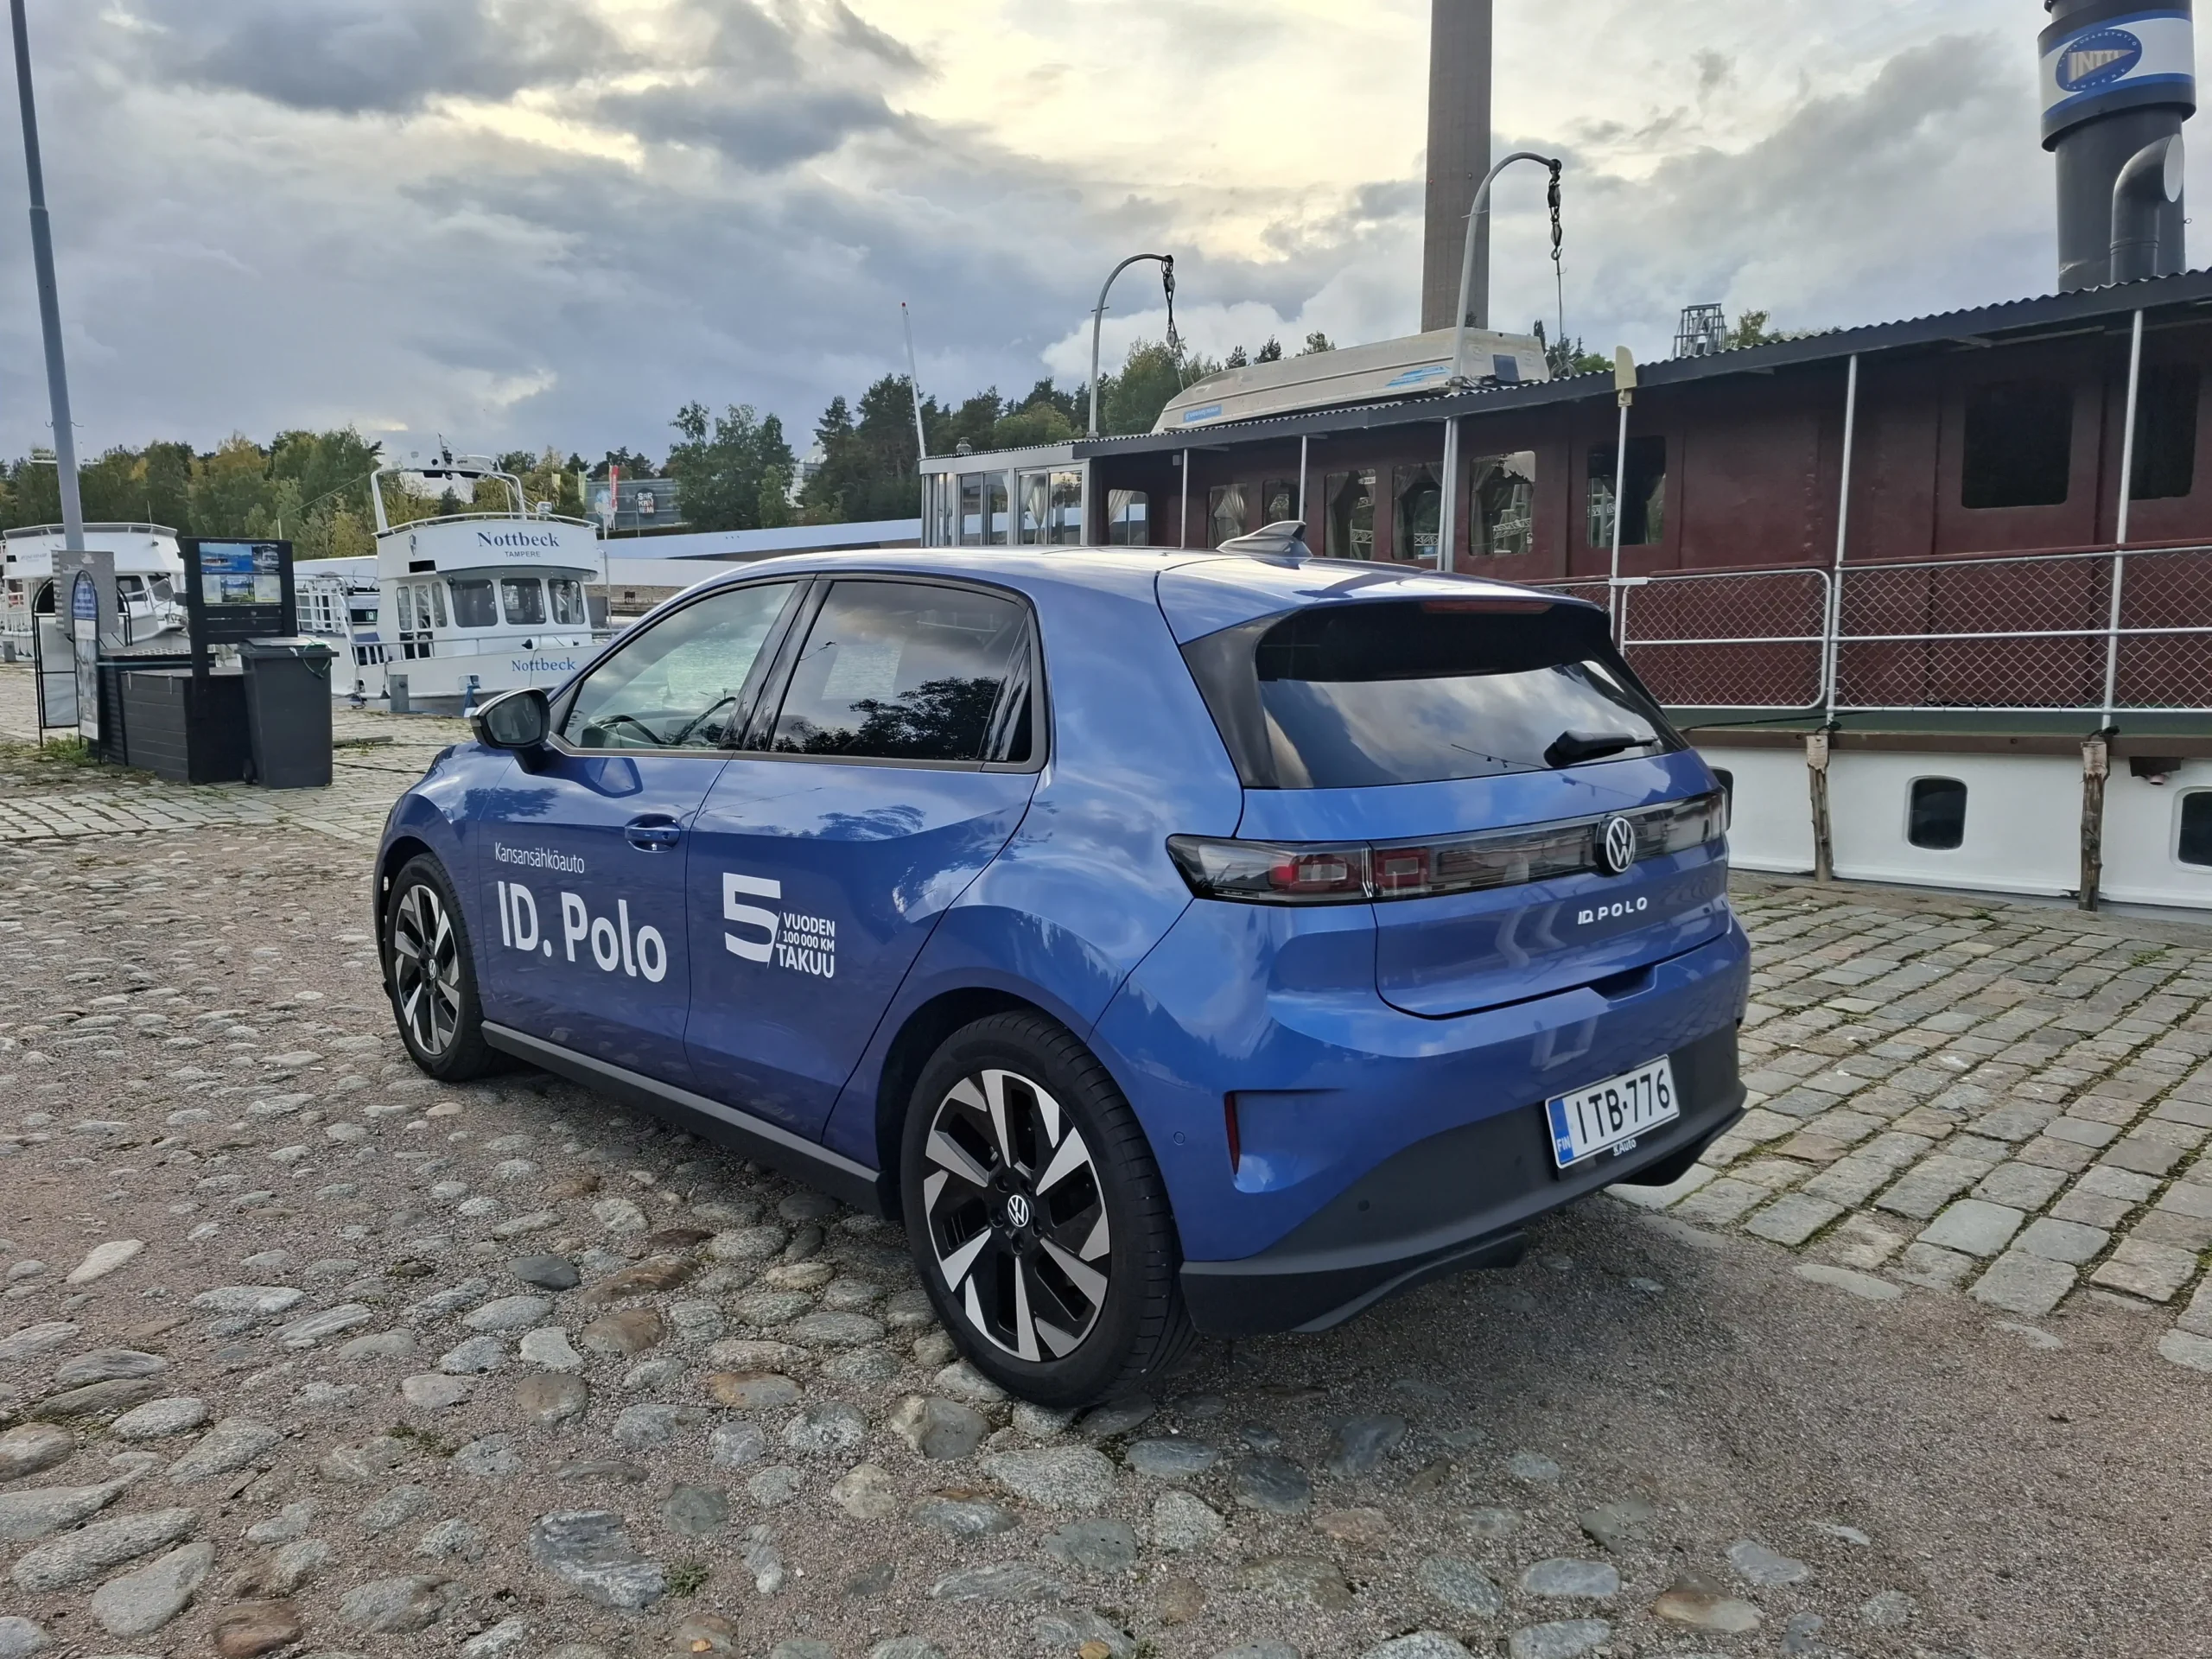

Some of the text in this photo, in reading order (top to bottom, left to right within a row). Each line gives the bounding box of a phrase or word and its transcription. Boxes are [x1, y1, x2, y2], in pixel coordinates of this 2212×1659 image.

[476, 531, 561, 547] Nottbeck
[512, 657, 577, 672] Nottbeck
[494, 842, 585, 874] Kansansähköauto
[722, 872, 781, 963] 5
[1597, 896, 1648, 920] POLO
[497, 880, 667, 983] ID. Polo
[783, 912, 836, 938] VUODEN
[820, 937, 835, 953] KM
[775, 943, 835, 979] TAKUU
[1576, 1068, 1670, 1145] ITB-776
[1556, 1135, 1572, 1153] FIN
